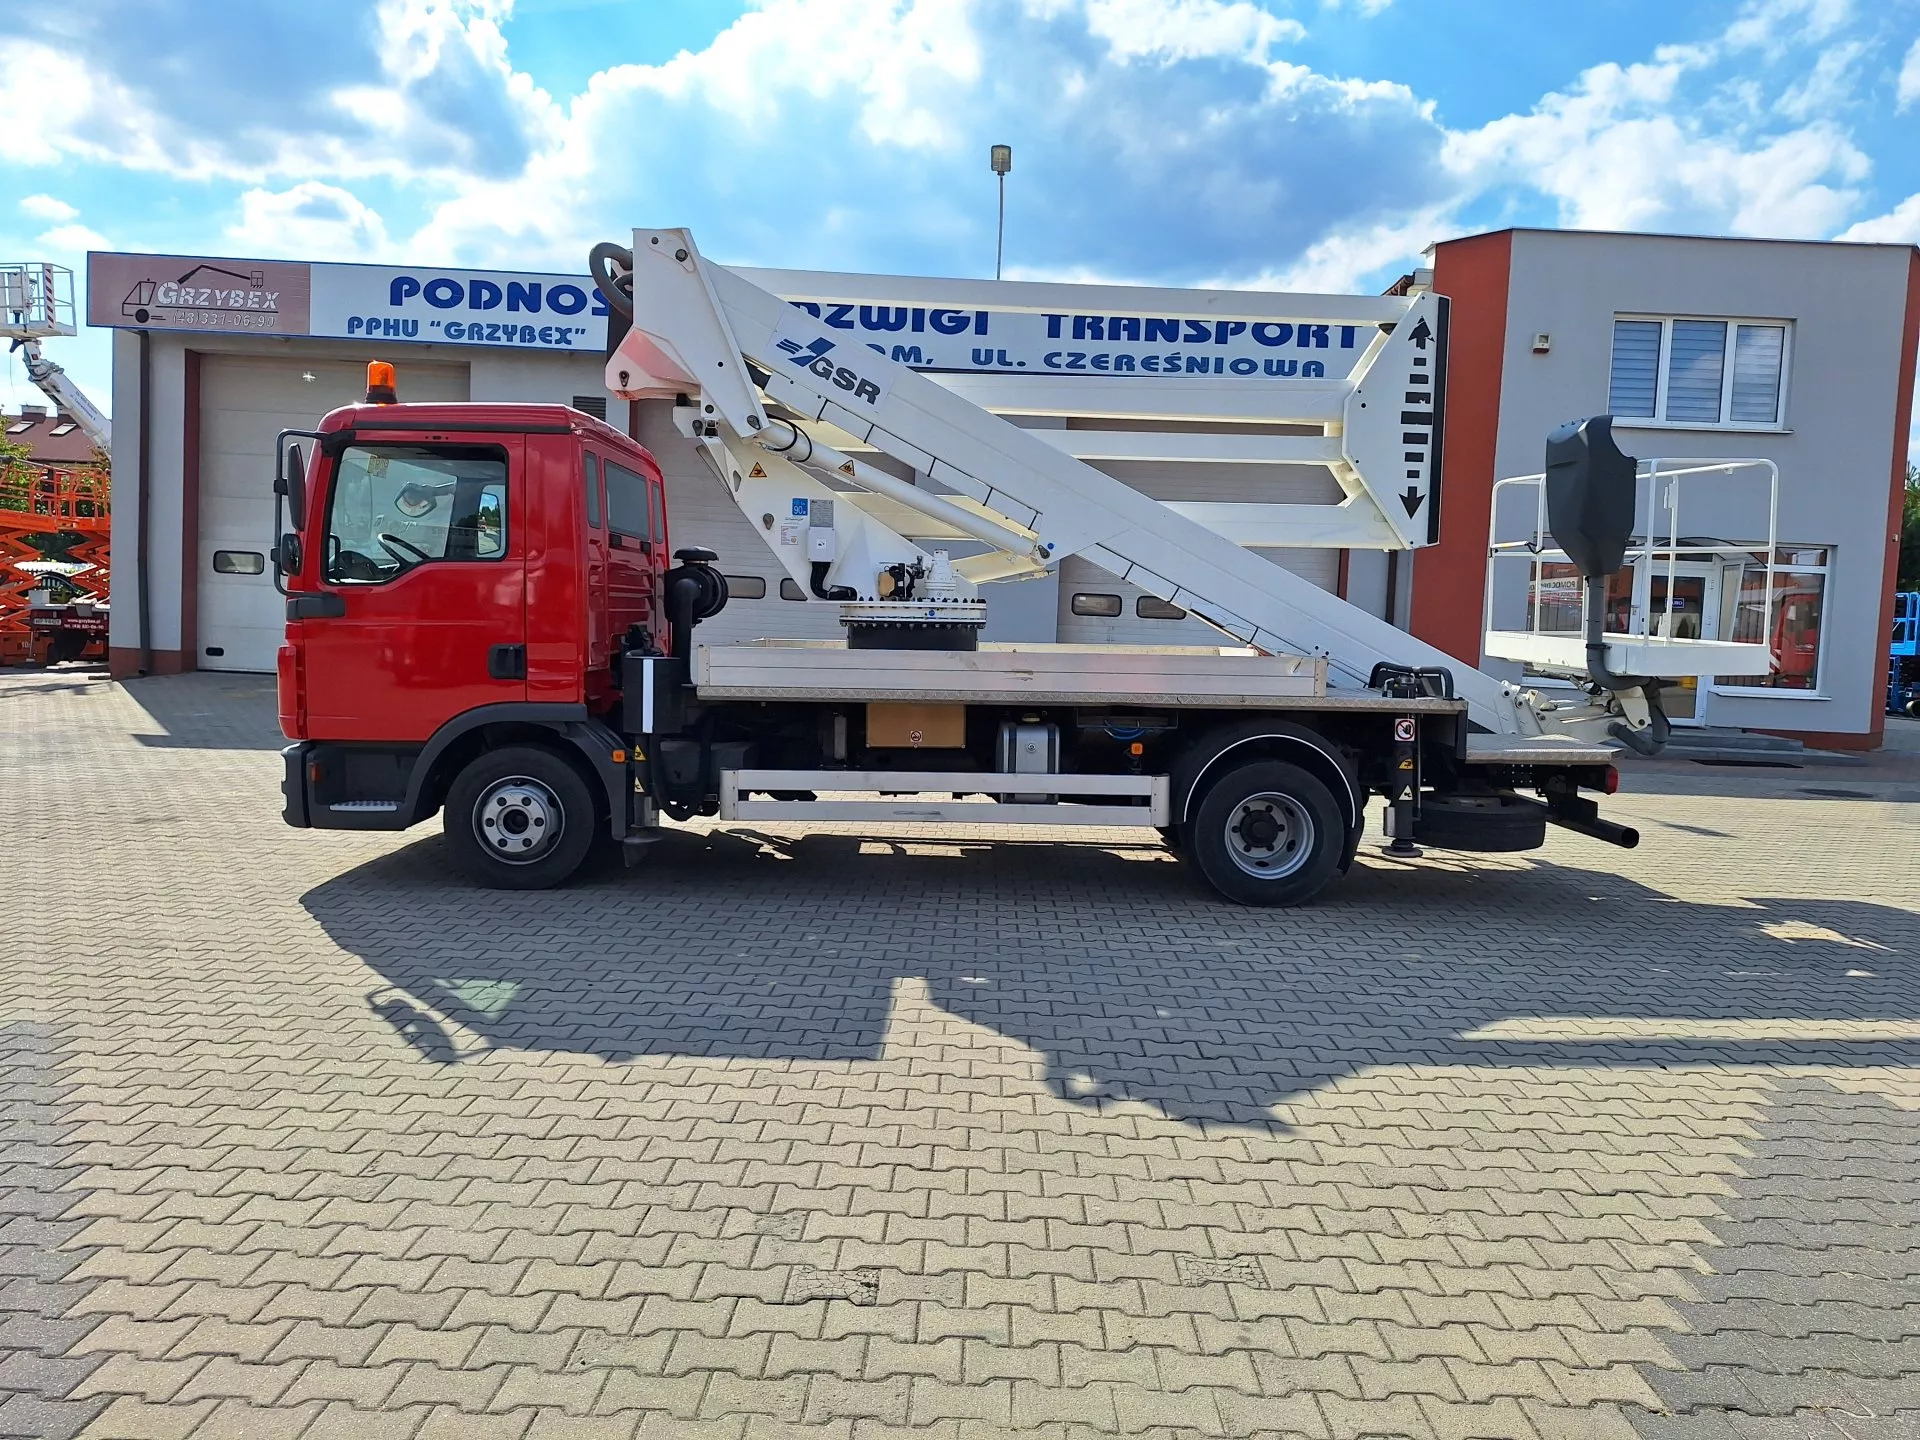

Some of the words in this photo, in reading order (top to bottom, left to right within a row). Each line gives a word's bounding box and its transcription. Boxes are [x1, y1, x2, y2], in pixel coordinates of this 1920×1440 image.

[157, 281, 280, 310] GRZYBEX
[347, 315, 419, 338] PPHU
[971, 347, 1027, 367] UL.
[1043, 351, 1326, 378] CZEREŚNIOWA
[1041, 313, 1363, 349] TRANSPORT
[808, 356, 882, 405] GSR
